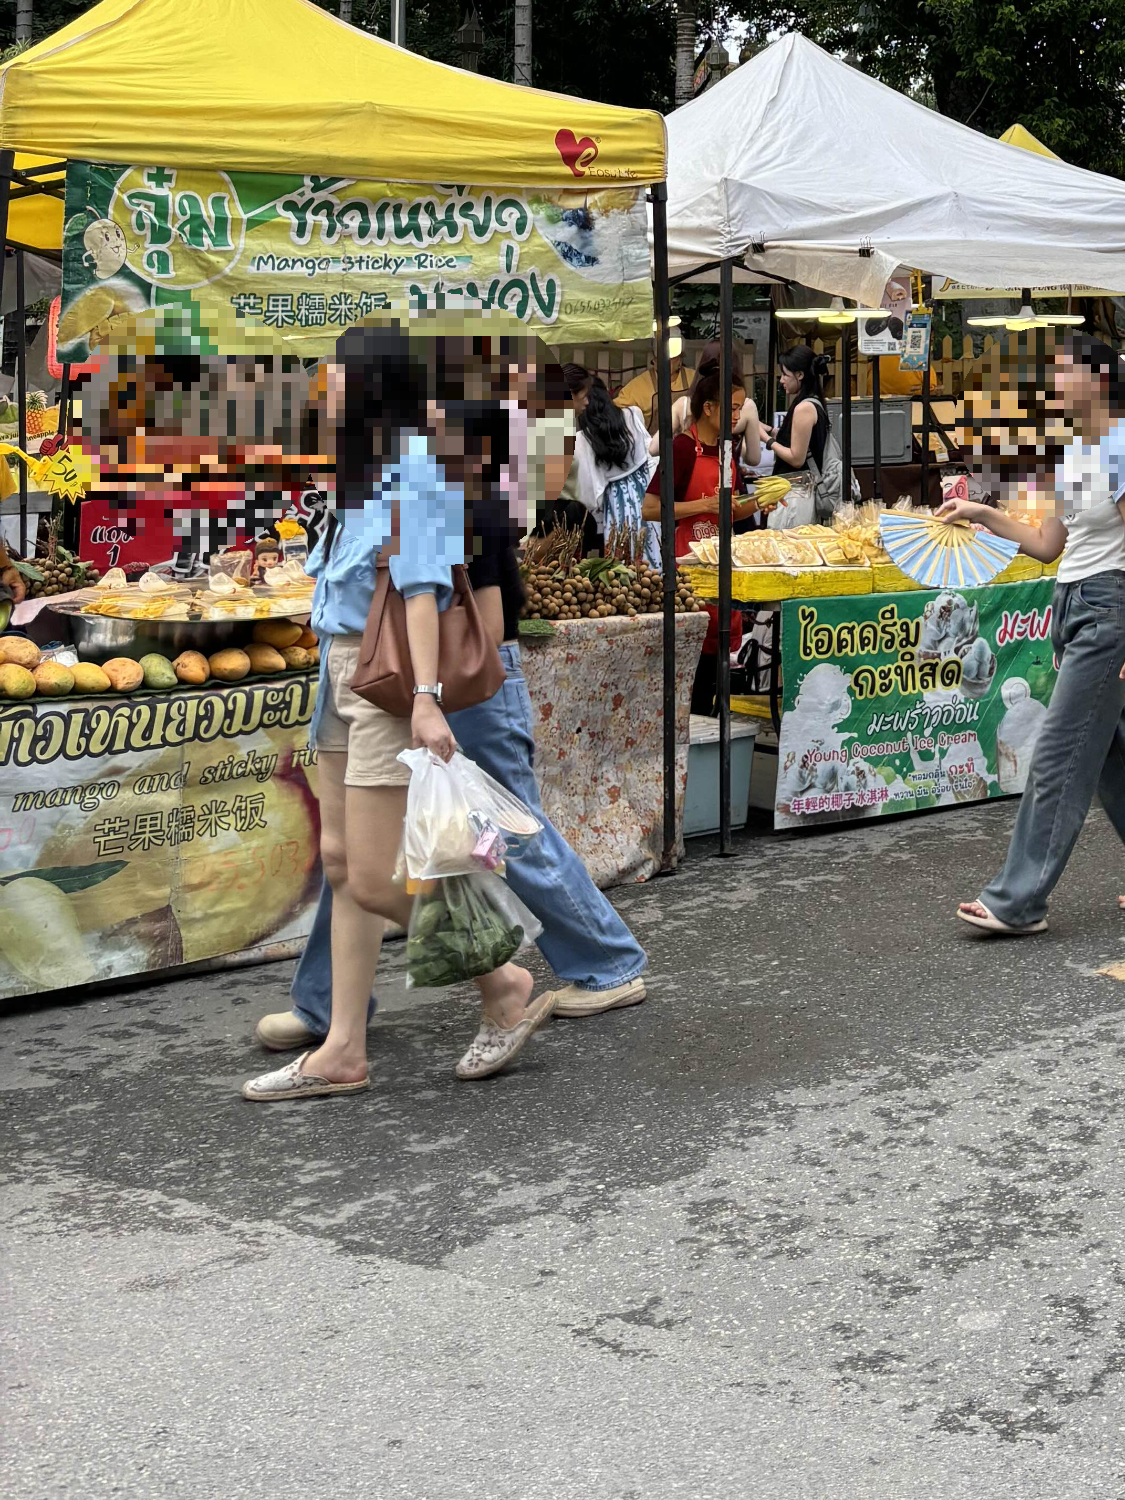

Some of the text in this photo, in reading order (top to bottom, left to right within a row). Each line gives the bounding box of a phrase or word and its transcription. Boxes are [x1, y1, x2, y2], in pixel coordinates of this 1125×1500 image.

[256, 255, 330, 276] Mango
[342, 254, 405, 274] Sticky
[106, 543, 121, 567] 1
[854, 652, 962, 696] กะทิสด
[867, 695, 979, 736] มะพร้าวอ่อน
[806, 732, 977, 764] Young Coconut Ice Cream
[12, 779, 121, 812] mango
[133, 762, 191, 795] and
[200, 749, 278, 784] sticky
[92, 791, 268, 857] 芒果糯米饭
